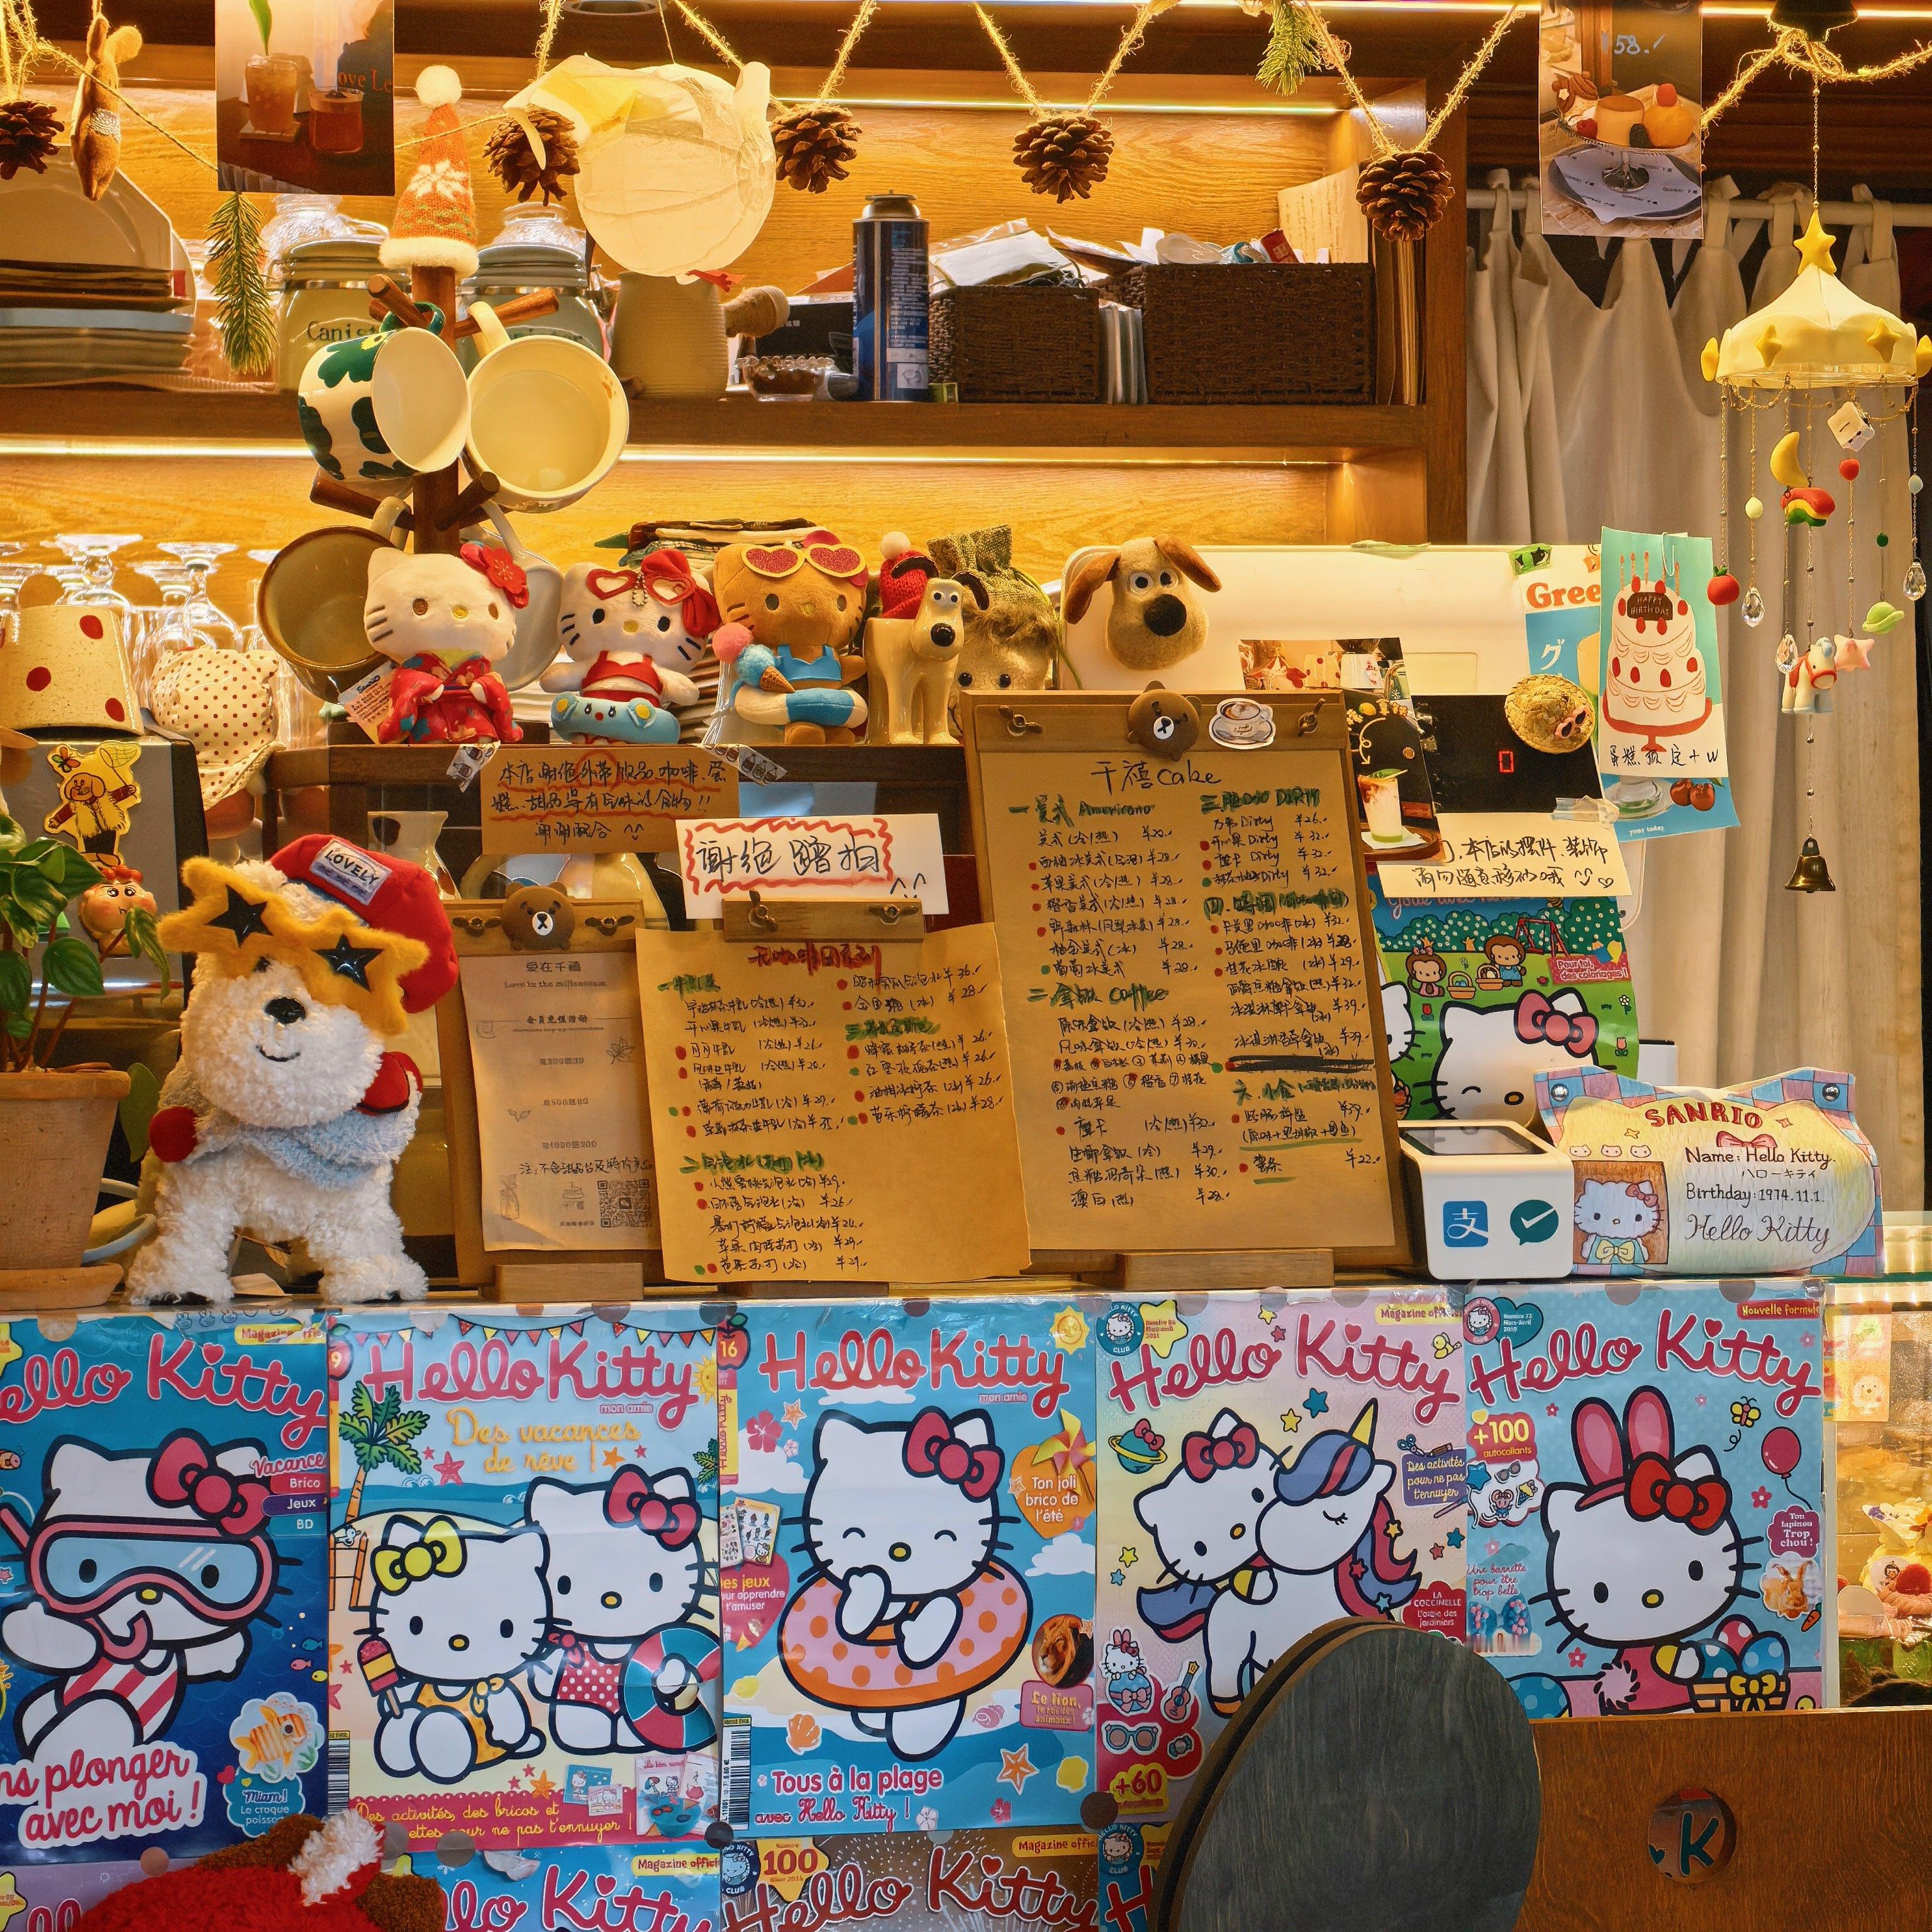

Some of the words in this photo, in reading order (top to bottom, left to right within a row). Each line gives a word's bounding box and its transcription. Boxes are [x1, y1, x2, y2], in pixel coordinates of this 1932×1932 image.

[1636, 594, 1663, 607] HAPPY
[322, 848, 381, 888] LOVELY
[1557, 960, 1578, 970] Pour
[1560, 969, 1578, 980] des
[1644, 1101, 1764, 1130] SANRIO
[1685, 1146, 1741, 1163] Name:
[1746, 1146, 1785, 1163] Hello
[1685, 1213, 1753, 1241] Hello
[1757, 1214, 1832, 1257] Kitty
[1741, 1304, 1783, 1317] Nouvelle
[721, 1340, 738, 1358] 16
[331, 1350, 341, 1368] 9
[1469, 1322, 1643, 1408] Hello
[1655, 1308, 1823, 1418] Kitty
[758, 1327, 928, 1394] Hello
[930, 1326, 1072, 1419] Kitty
[1108, 1326, 1284, 1413] Hello
[1296, 1313, 1460, 1426] Kitty
[147, 1332, 328, 1450] Kitty
[362, 1336, 545, 1403] Hello
[548, 1336, 699, 1431] Kitty
[447, 1406, 511, 1447] Des
[520, 1420, 642, 1448] vacances
[1473, 1419, 1530, 1445] +100
[1483, 1445, 1532, 1458] autocollants
[483, 1449, 518, 1475] de
[289, 1477, 321, 1489] Brico
[1031, 1477, 1054, 1491] Ton
[1057, 1475, 1078, 1493] joli
[1407, 1477, 1433, 1490] pour
[1433, 1476, 1445, 1484] ne
[1446, 1473, 1465, 1485] pas
[286, 1497, 316, 1510] Jeux
[1025, 1491, 1058, 1507] brico
[1061, 1492, 1080, 1507] de
[296, 1518, 314, 1530] BD
[1789, 1511, 1806, 1521] Ton
[1780, 1536, 1807, 1548] chou
[1783, 1529, 1811, 1542] Trop
[742, 1574, 770, 1593] jeux
[737, 1588, 786, 1603] apprendre
[1414, 1598, 1461, 1607] COCCINELLE
[1433, 1591, 1443, 1599] LA
[45, 1748, 191, 1812] plonger
[770, 1769, 823, 1795] Tous
[828, 1764, 845, 1793] à
[849, 1764, 874, 1792] la
[877, 1762, 944, 1802] plage
[1115, 1768, 1163, 1797] +60
[26, 1804, 105, 1843] avec
[108, 1789, 184, 1832] moi
[241, 1806, 252, 1815] Le
[255, 1806, 289, 1816] croque
[462, 1802, 489, 1820] des
[494, 1796, 539, 1819] bricos
[545, 1801, 560, 1816] et
[754, 1809, 793, 1825] avec
[796, 1795, 847, 1825] Hello
[851, 1795, 898, 1835] Kitty
[245, 1815, 284, 1826] poisso
[489, 1826, 509, 1837] ne
[516, 1823, 544, 1848] pas
[1678, 1809, 1721, 1877] K
[1017, 1839, 1068, 1855] Magazine
[637, 1858, 687, 1875] Magazine
[763, 1848, 818, 1875] 100
[726, 1885, 746, 1894] CLUB
